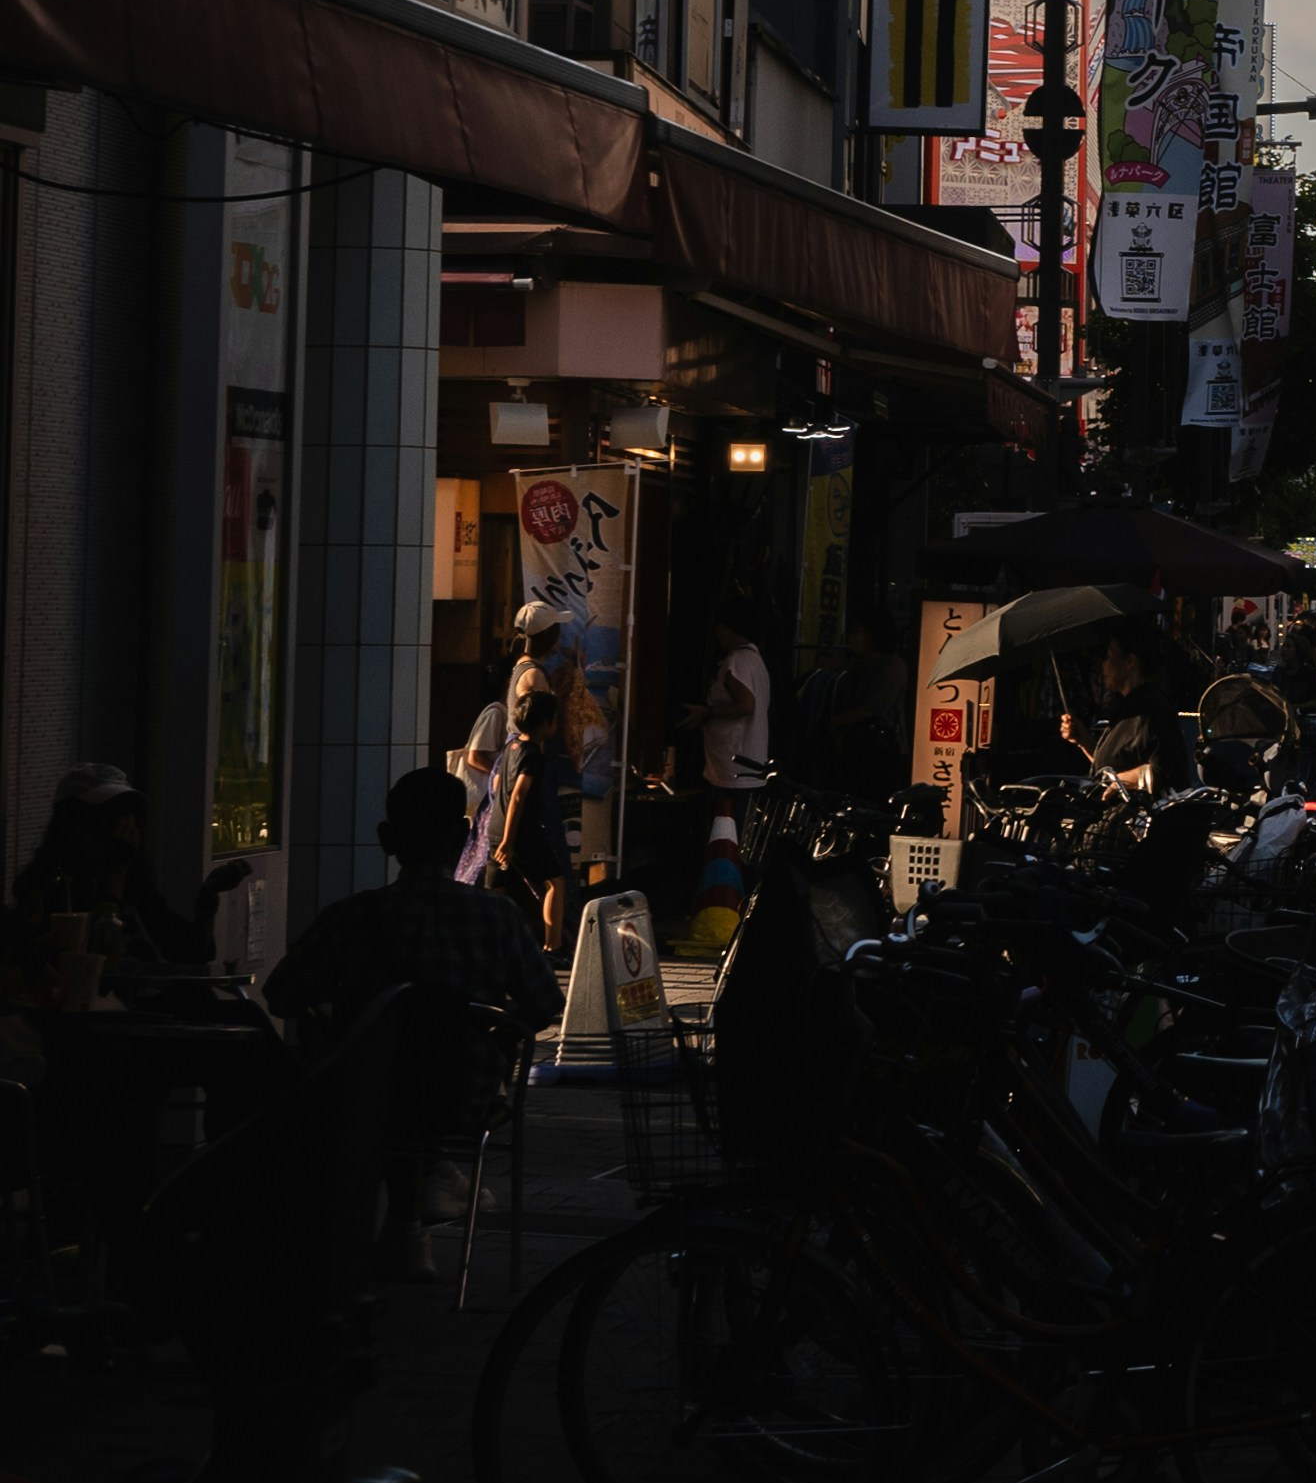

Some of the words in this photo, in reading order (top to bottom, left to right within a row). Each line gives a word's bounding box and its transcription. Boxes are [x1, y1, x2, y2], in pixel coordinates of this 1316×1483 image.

[951, 127, 1031, 164] アミュ
[1110, 165, 1165, 183] ルナパーク
[1242, 213, 1281, 340] 富士館
[937, 607, 962, 703] とつ
